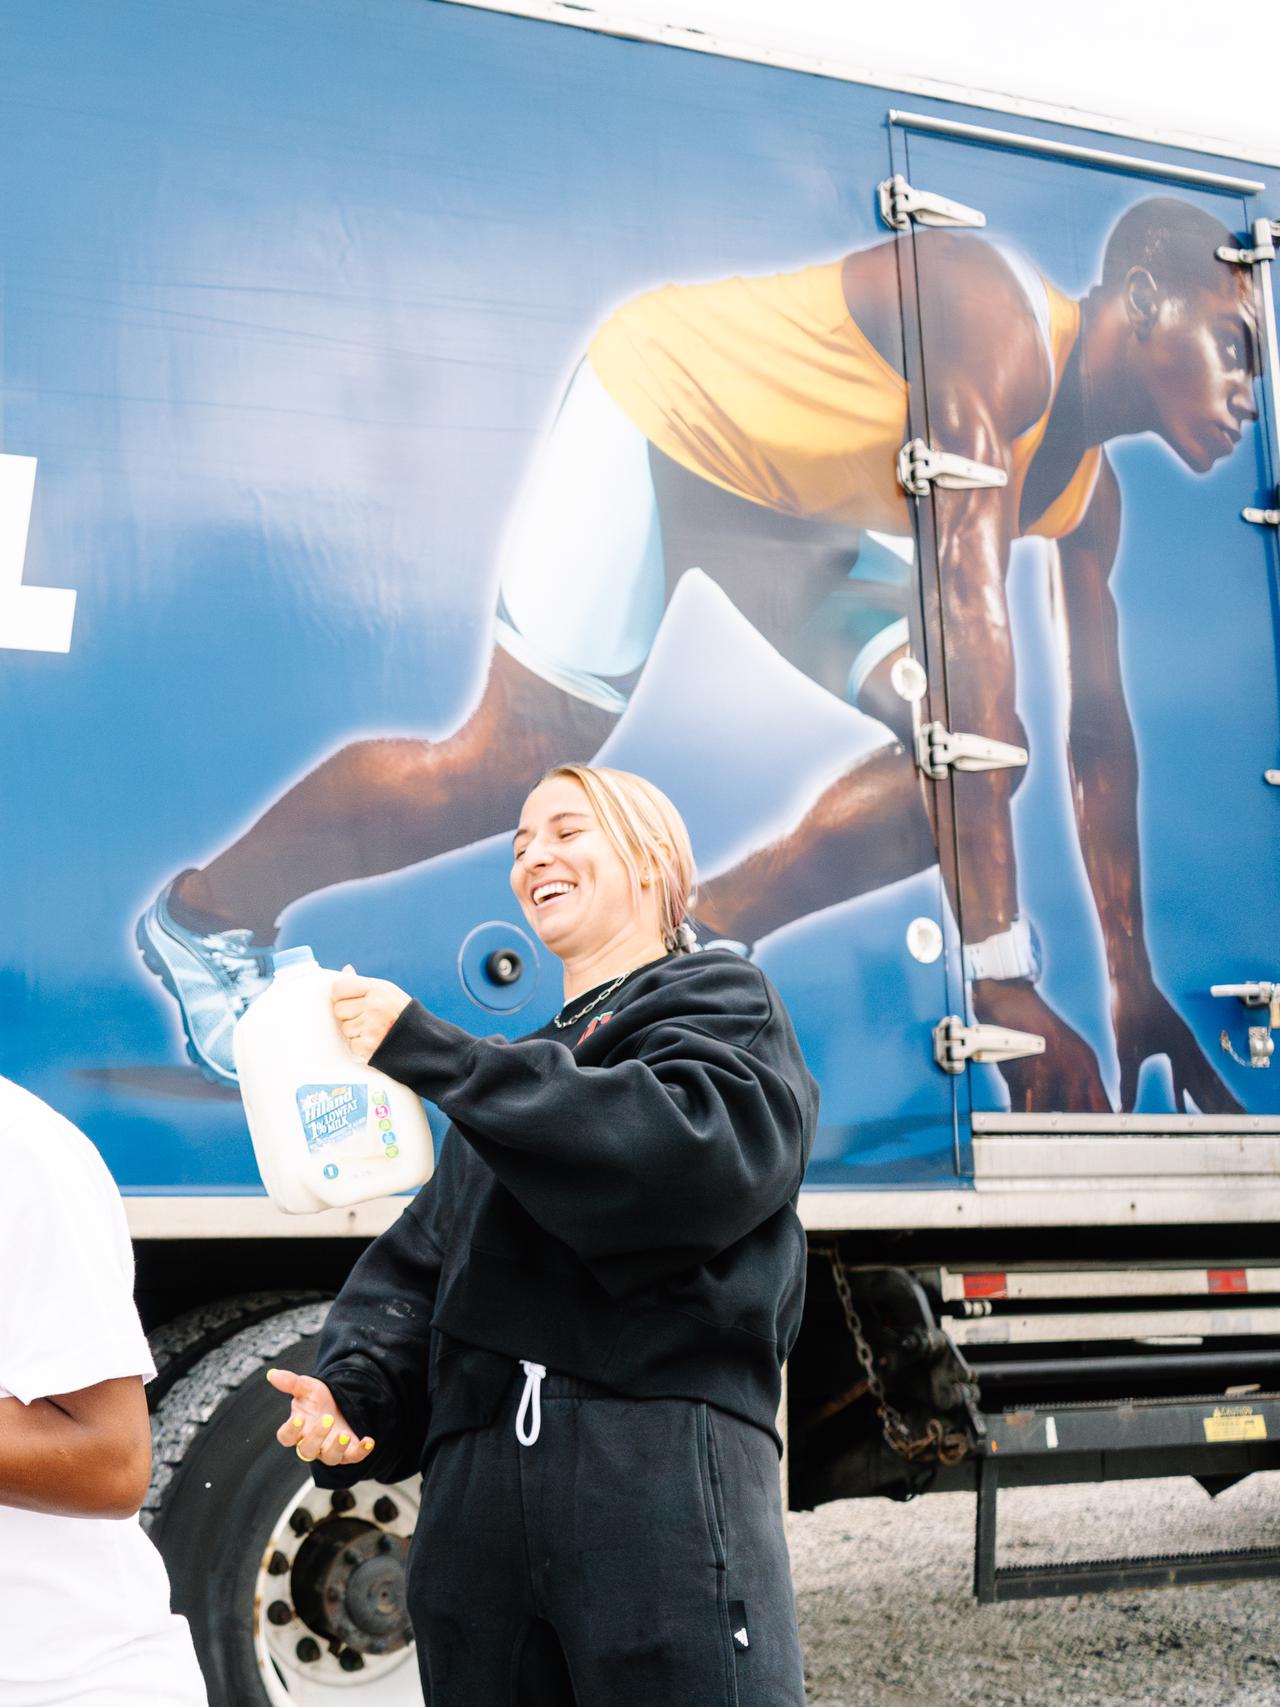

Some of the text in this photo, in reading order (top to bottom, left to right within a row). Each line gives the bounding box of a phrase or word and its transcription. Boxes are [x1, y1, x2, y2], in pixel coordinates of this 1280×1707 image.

[303, 1086, 353, 1123] Hiland
[306, 1120, 327, 1140] 1%
[324, 1099, 358, 1123] LOWFAT
[327, 1116, 349, 1134] MILK
